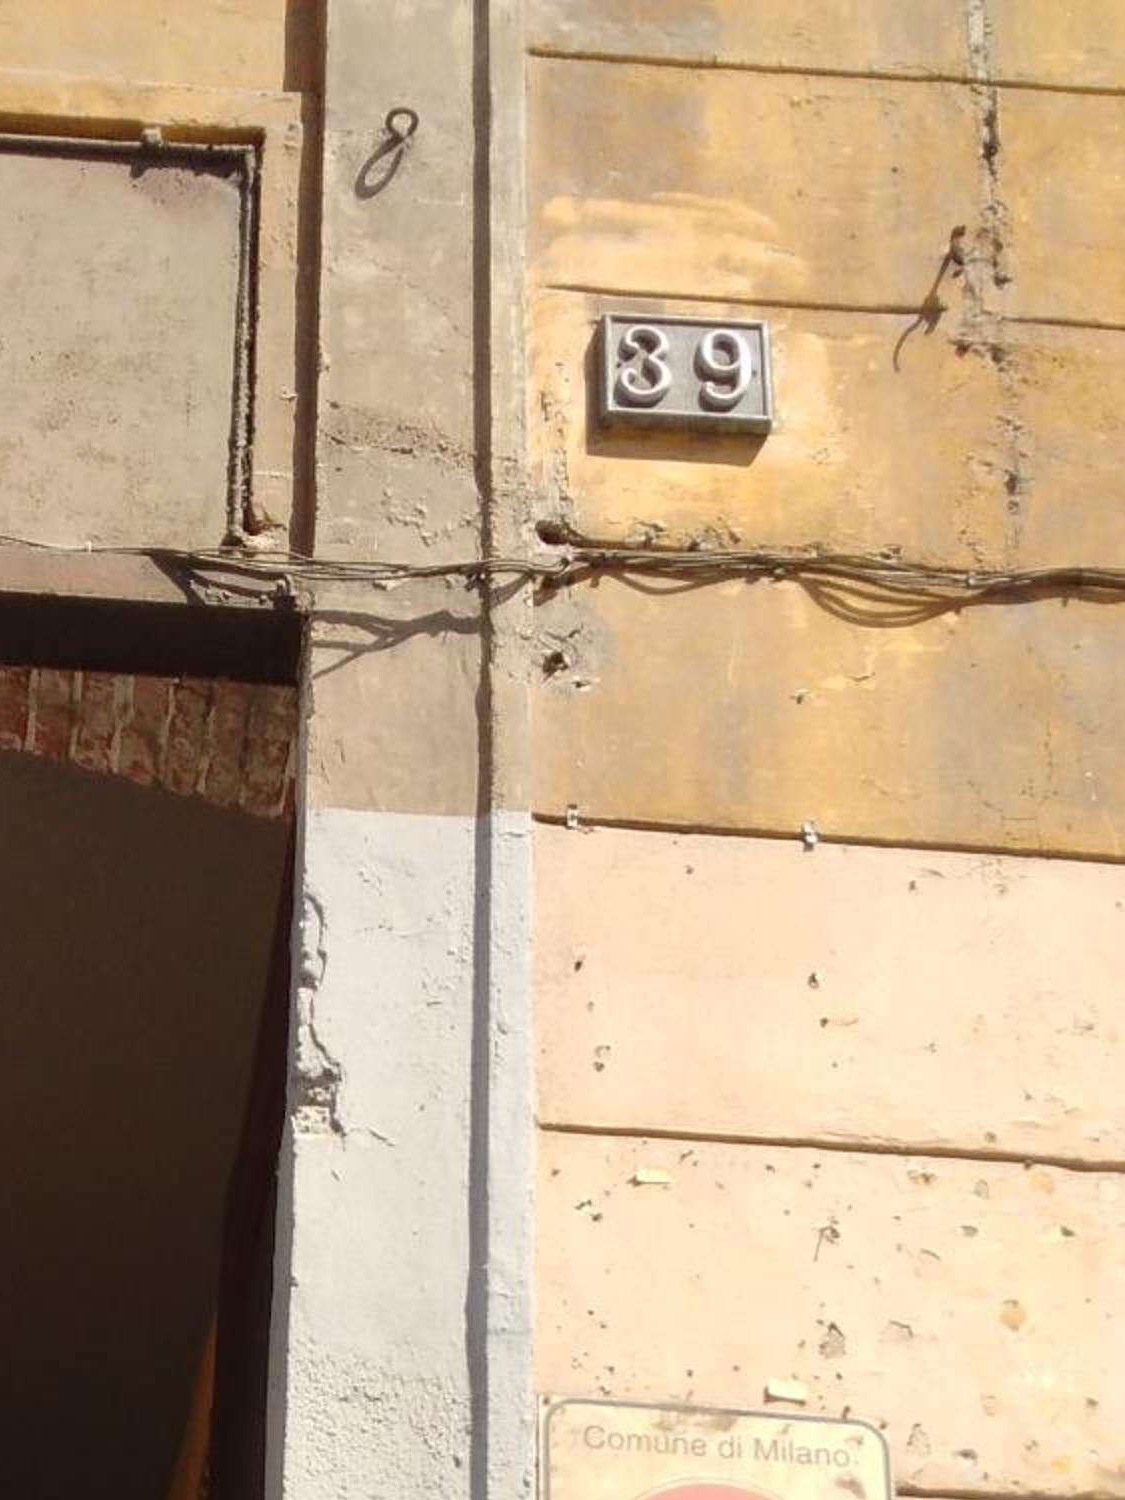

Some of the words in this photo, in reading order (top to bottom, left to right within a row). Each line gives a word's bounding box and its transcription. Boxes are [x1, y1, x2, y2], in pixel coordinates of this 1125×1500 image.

[615, 325, 752, 411] 39
[583, 1424, 707, 1458] Comune
[718, 1436, 743, 1460] di
[753, 1440, 851, 1468] Milano
